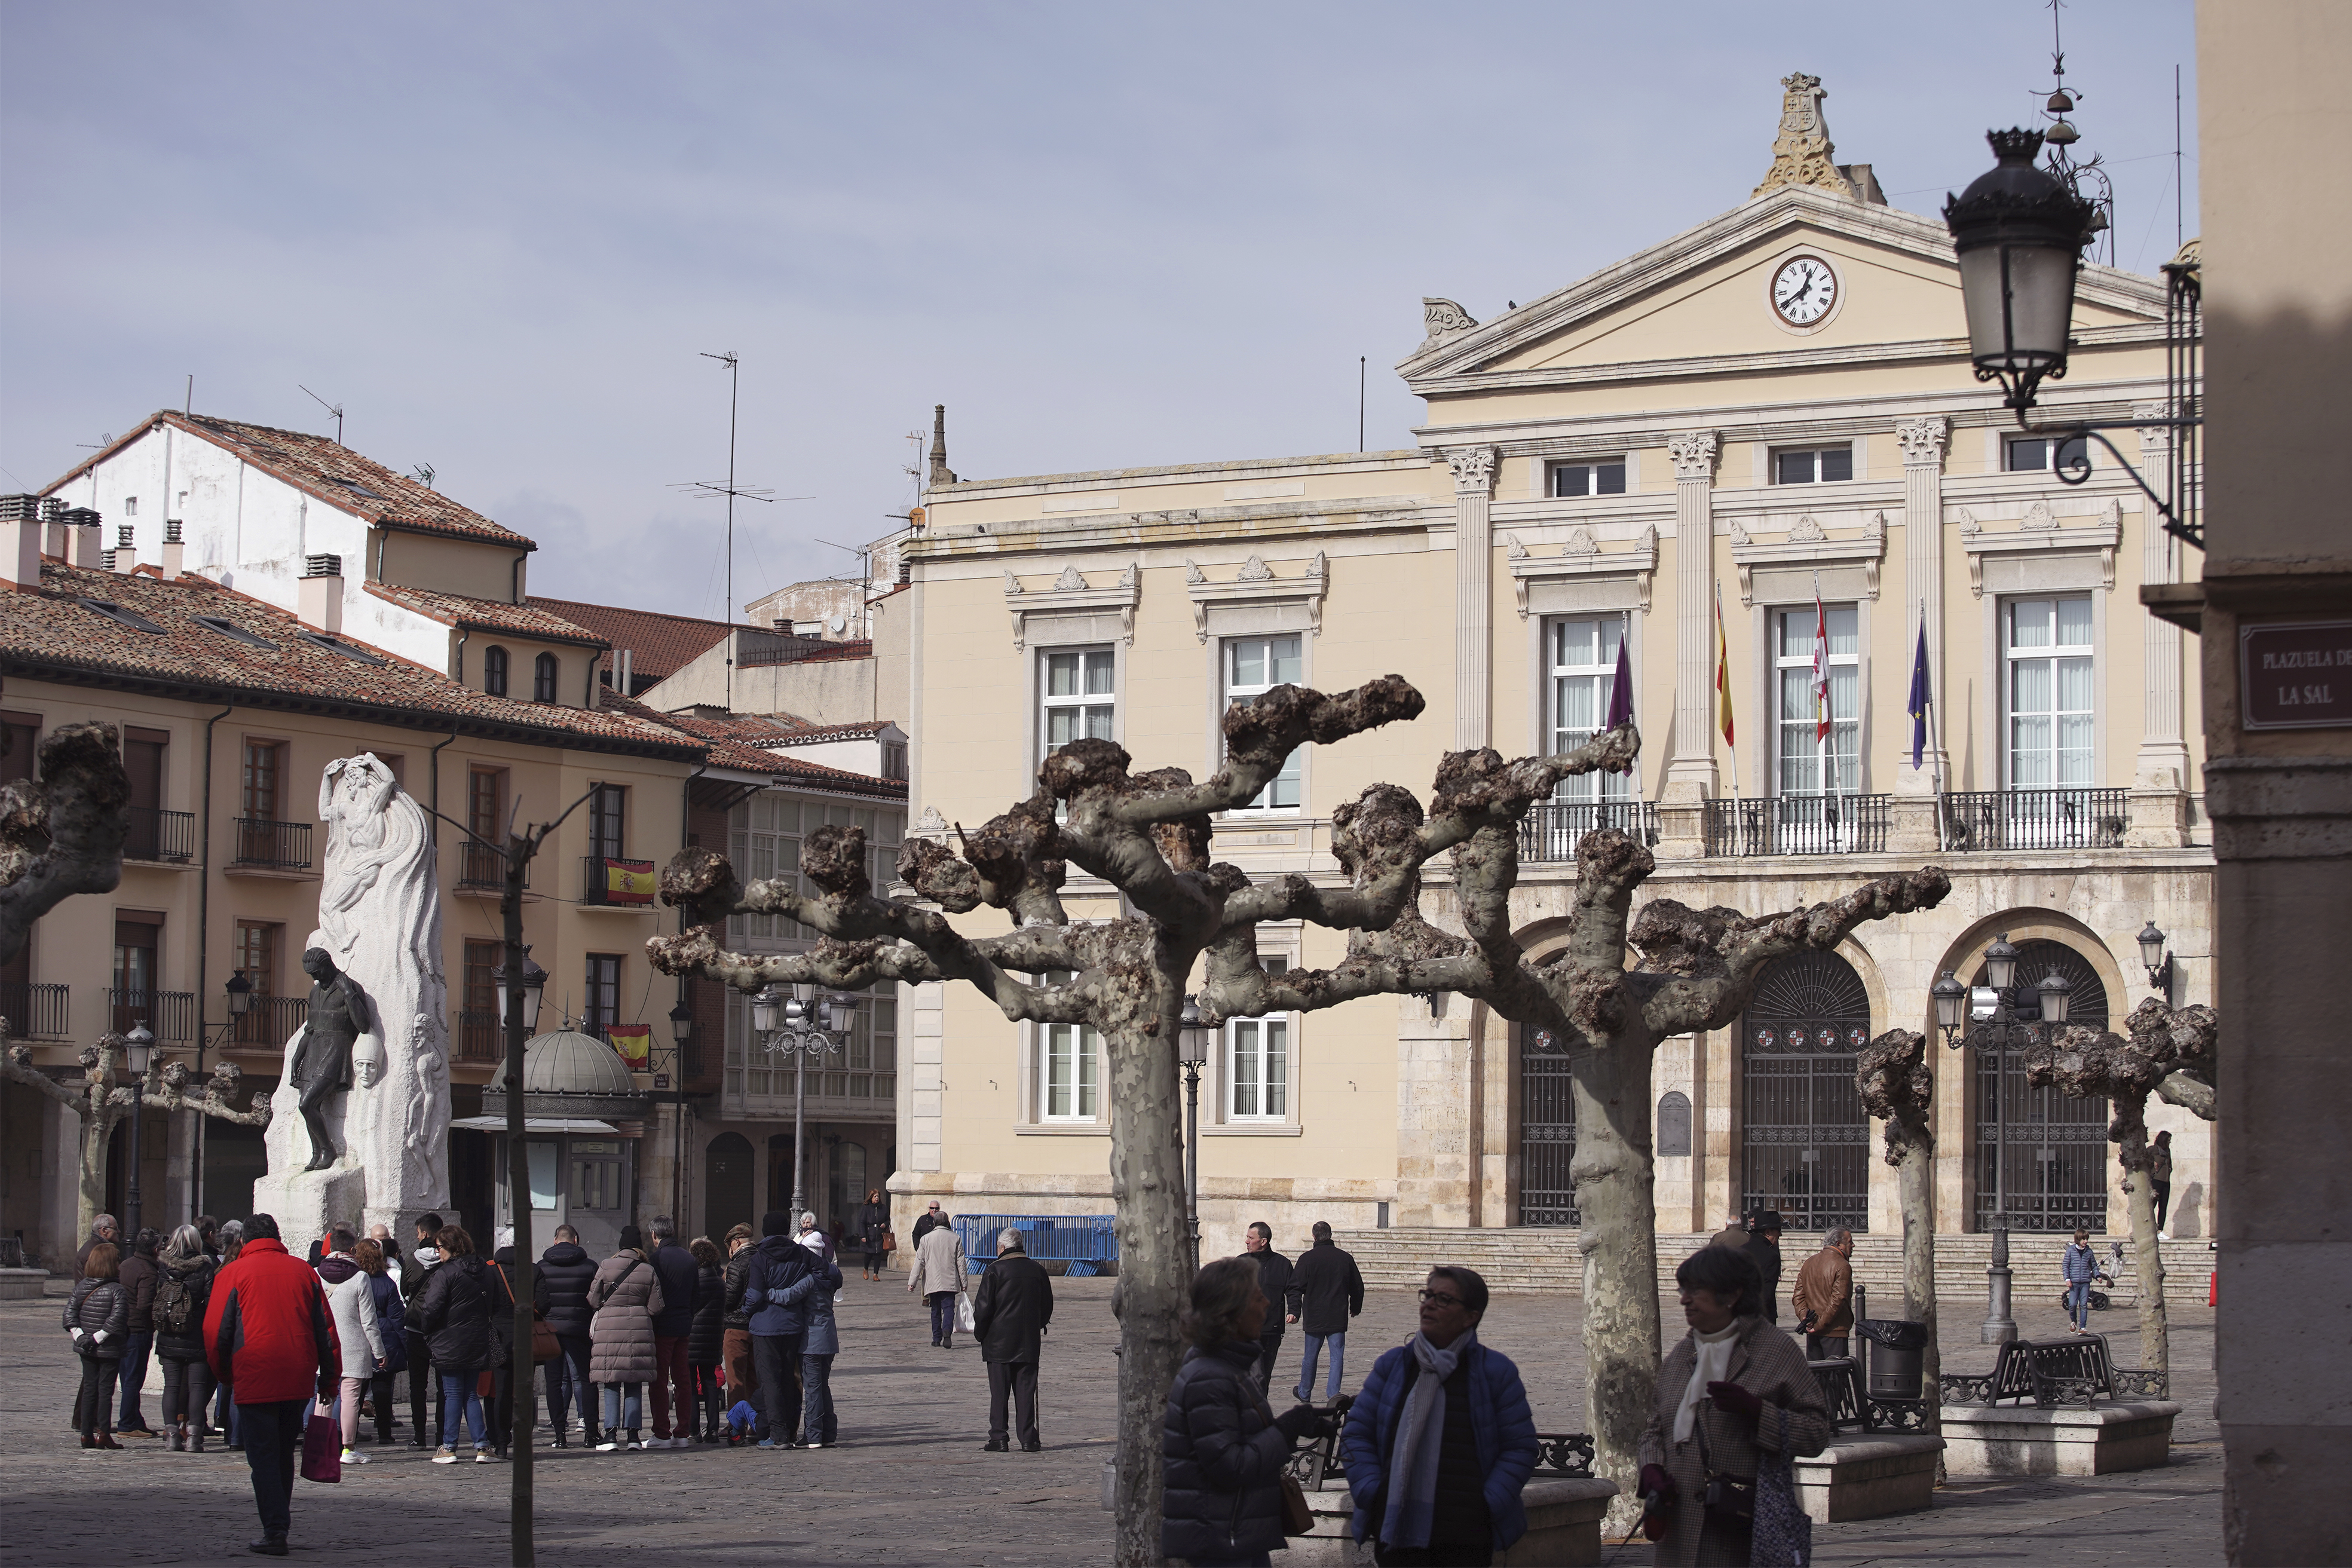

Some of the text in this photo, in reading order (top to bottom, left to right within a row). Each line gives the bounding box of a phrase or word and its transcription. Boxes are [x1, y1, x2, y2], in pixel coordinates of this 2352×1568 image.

[2262, 648, 2352, 669] PLAZUELA DE
[2277, 684, 2335, 706] LA SAL
